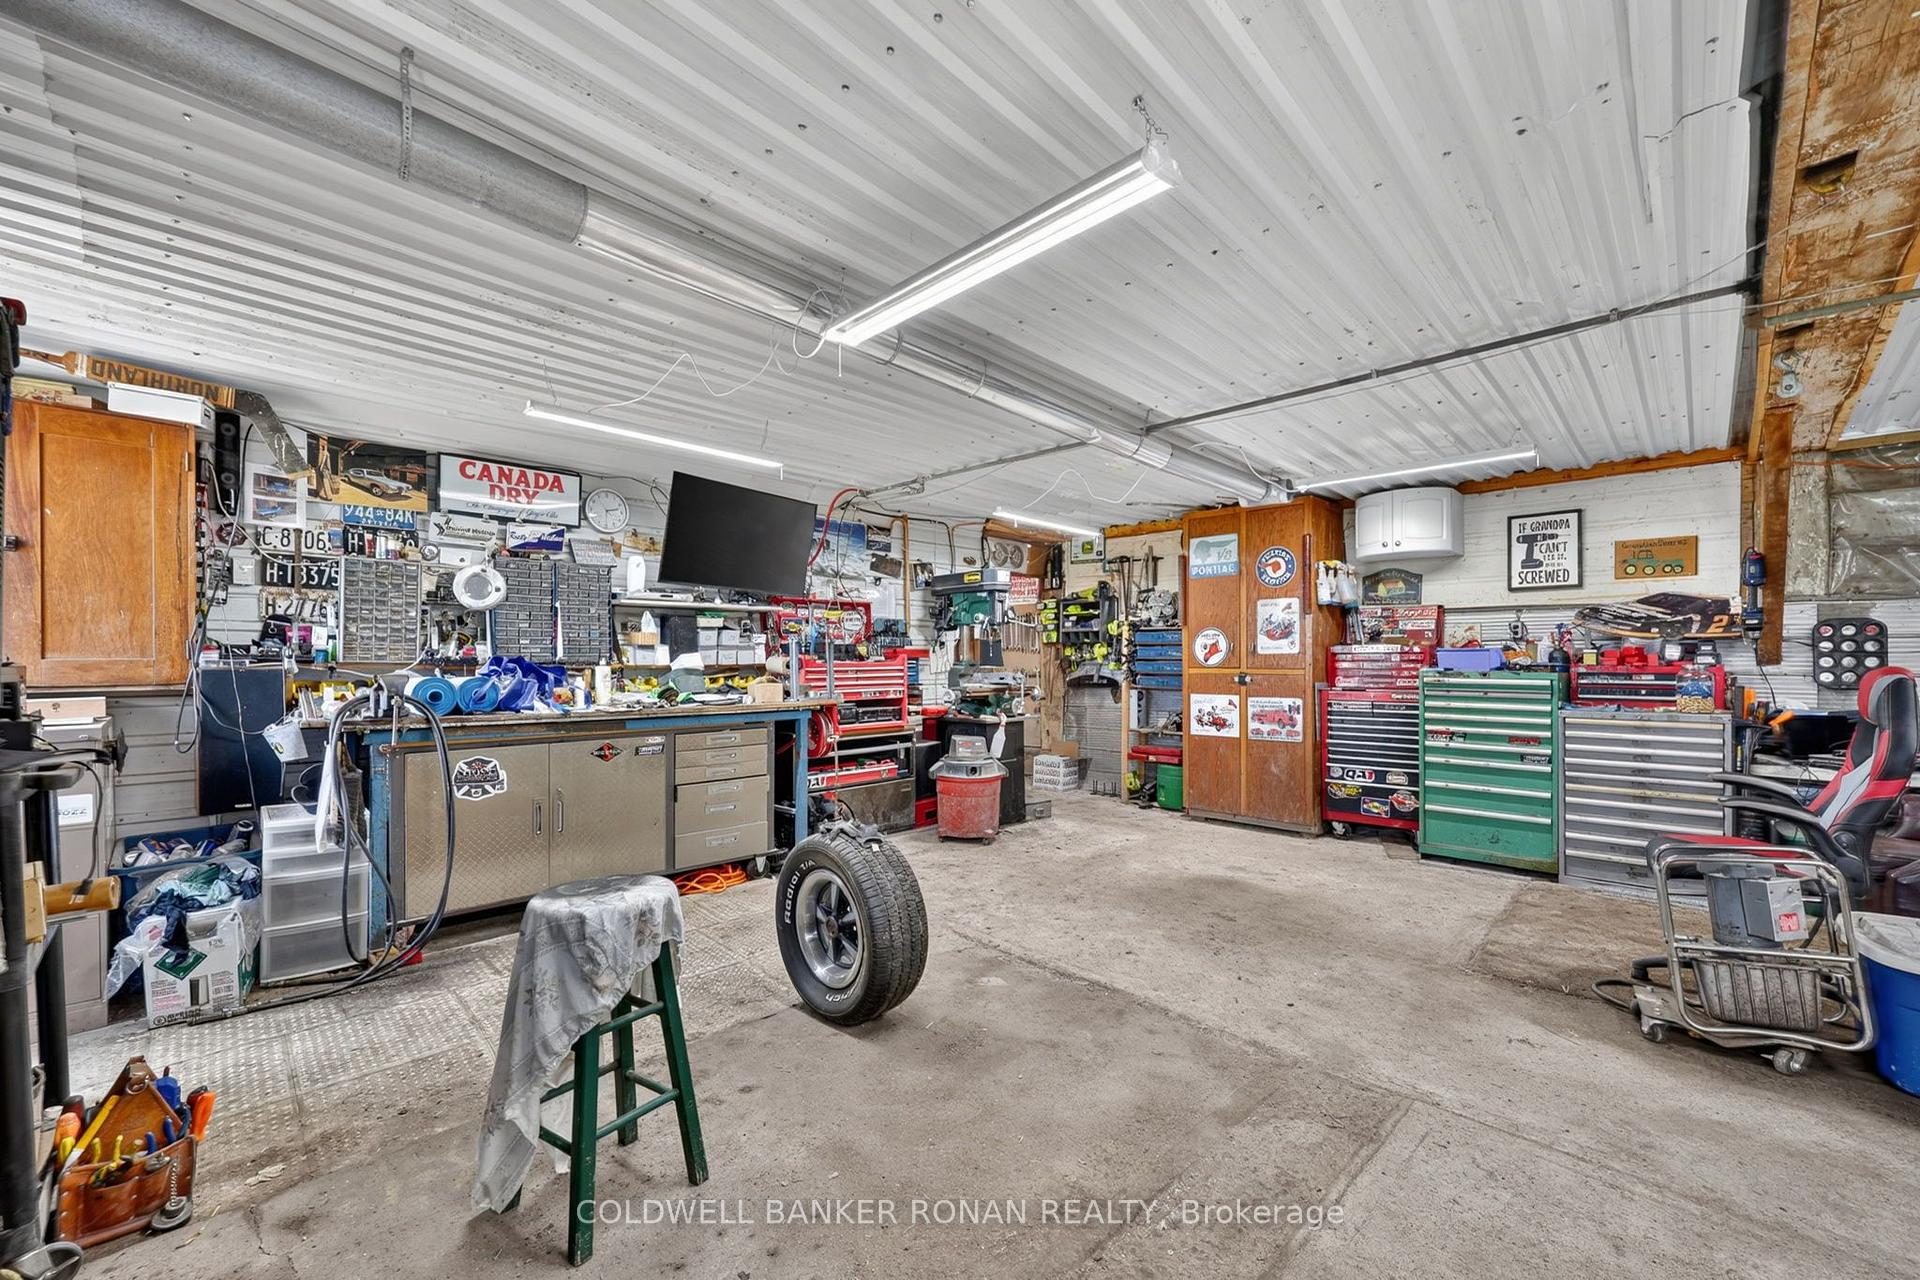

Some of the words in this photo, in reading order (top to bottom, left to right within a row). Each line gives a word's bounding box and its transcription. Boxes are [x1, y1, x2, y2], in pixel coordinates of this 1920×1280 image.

[458, 460, 565, 493] CANADA
[488, 484, 540, 505] DRY
[1518, 522, 1528, 534] IF
[1530, 518, 1571, 532] GRANDPA
[1190, 563, 1236, 576] PONTIAC
[1518, 568, 1570, 585] SCREWED
[1706, 615, 1729, 634] 2
[784, 871, 801, 924] Radial
